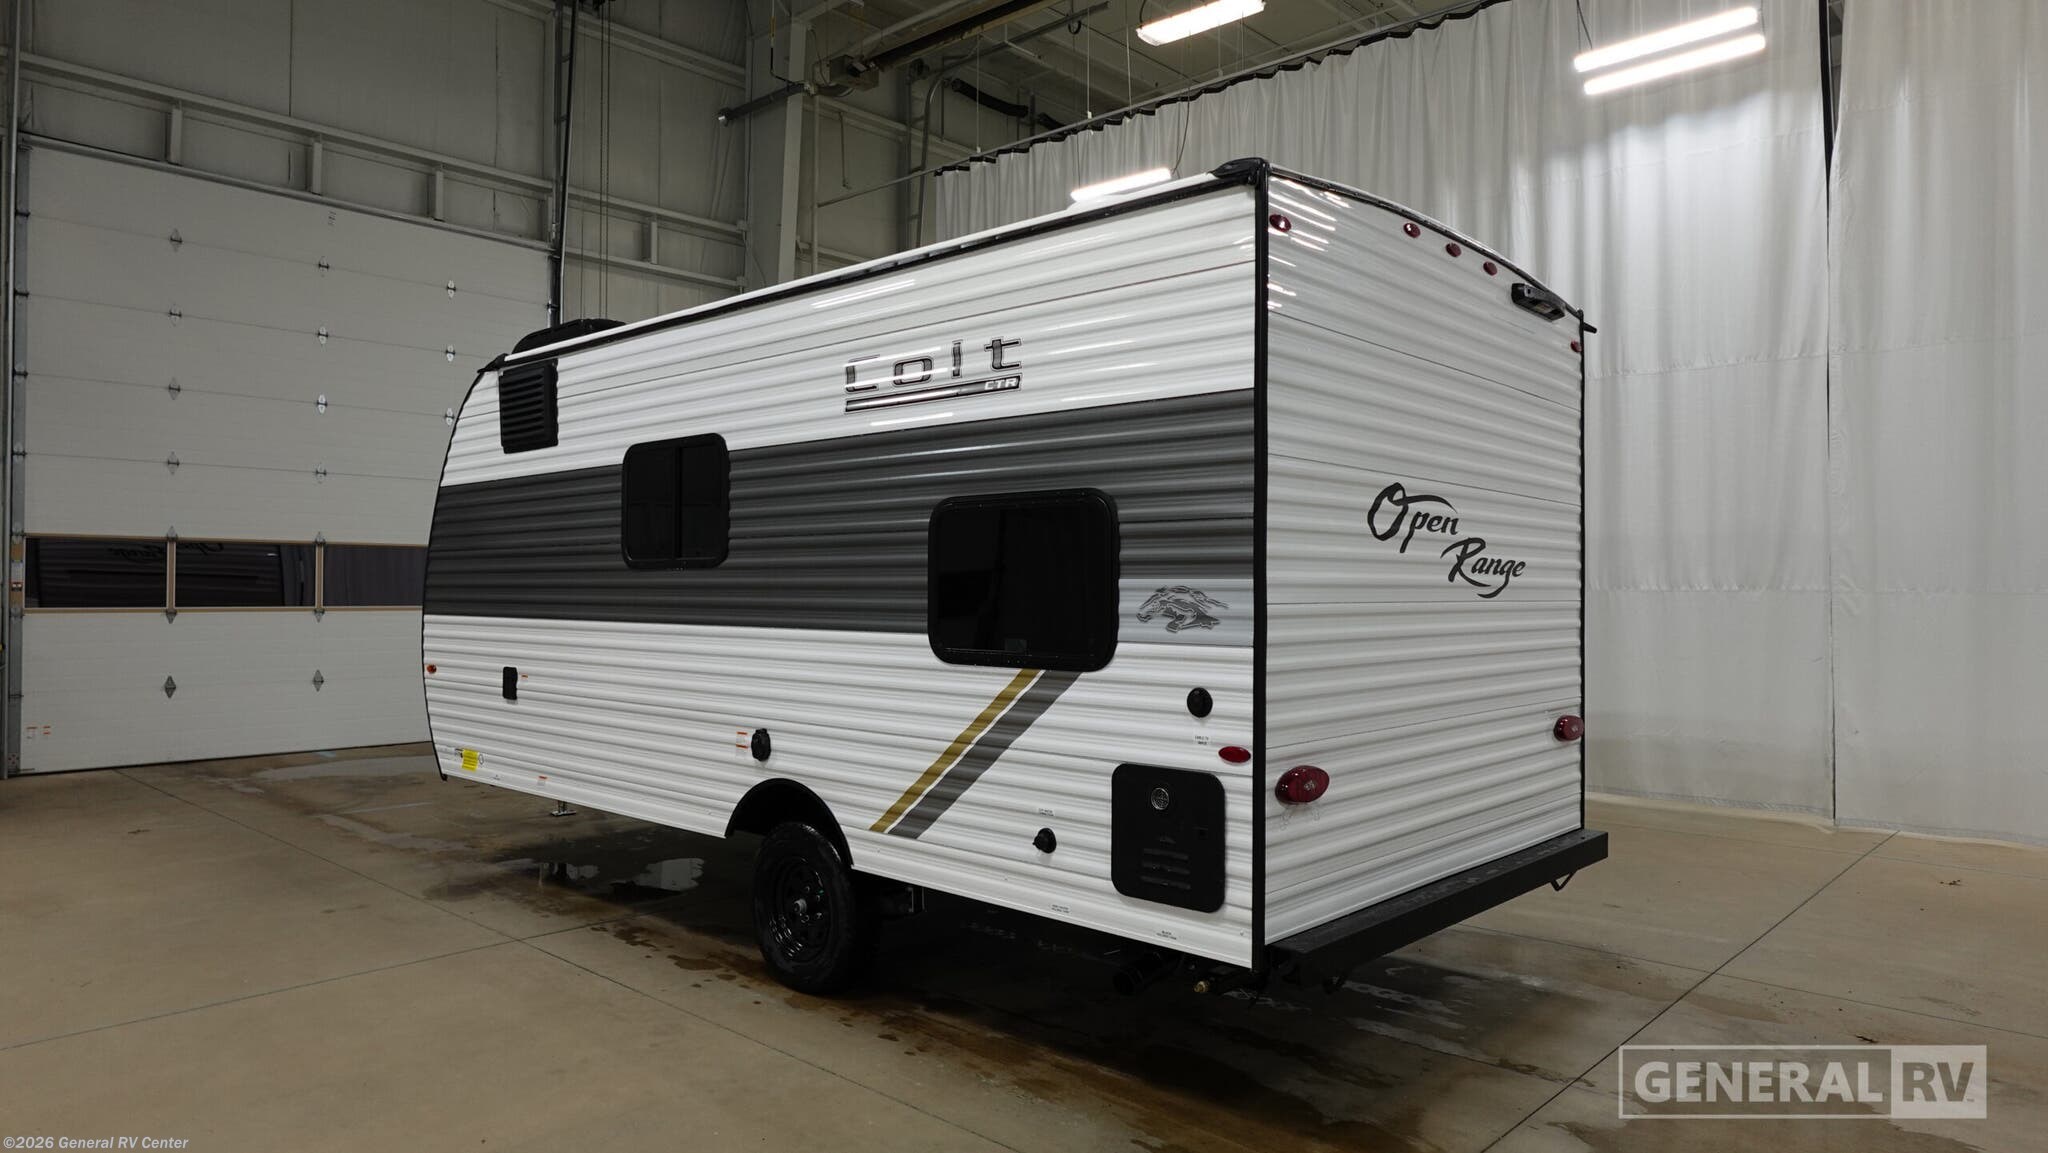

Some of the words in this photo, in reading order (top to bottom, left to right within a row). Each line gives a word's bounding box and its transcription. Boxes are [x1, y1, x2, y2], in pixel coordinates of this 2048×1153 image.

[984, 377, 1017, 391] CTR
[1367, 482, 1459, 553] Open
[1440, 537, 1526, 598] Range
